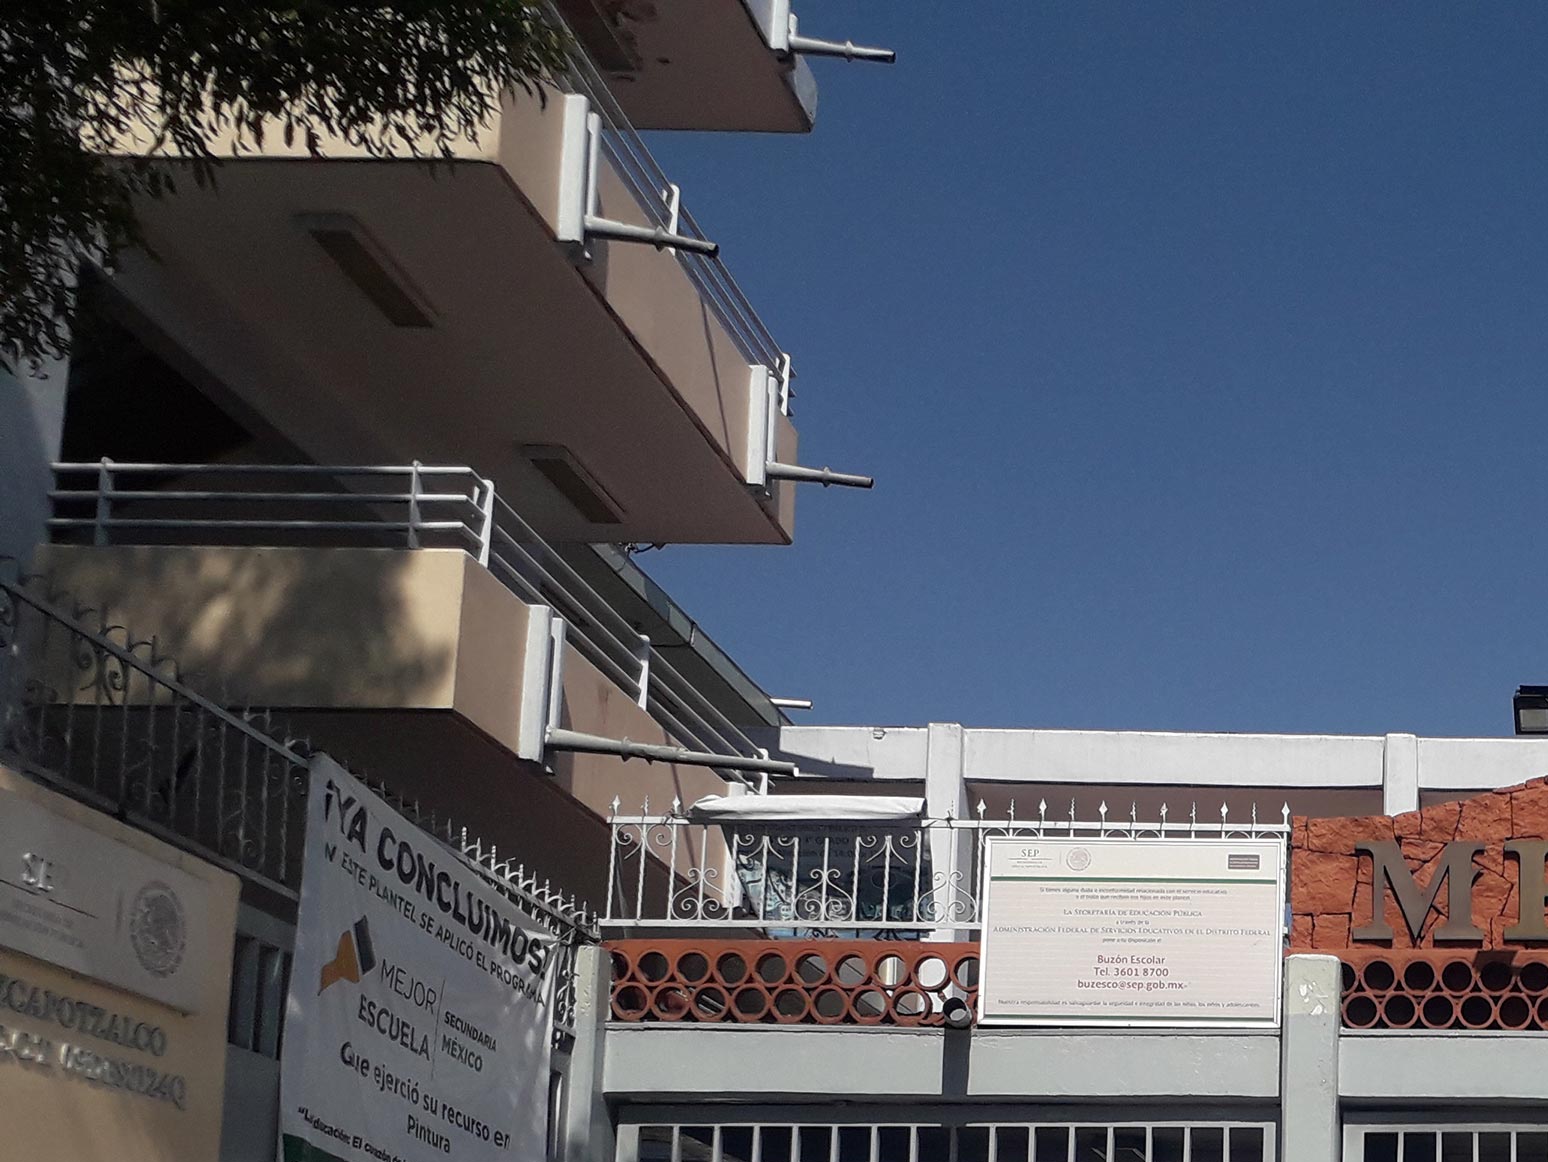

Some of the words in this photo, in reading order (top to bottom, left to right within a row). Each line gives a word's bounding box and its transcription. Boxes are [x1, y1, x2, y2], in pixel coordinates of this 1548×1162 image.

[1020, 848, 1040, 858] SEP
[341, 851, 368, 886] ESTE
[368, 874, 417, 924] PLANTEL
[418, 911, 435, 934] SE
[435, 924, 474, 961] APLICÓ
[476, 950, 488, 972] EL
[377, 826, 549, 981] CONCLUIMOS!
[1094, 967, 1110, 976] Tel.
[1113, 967, 1139, 976] 3601
[1142, 968, 1169, 977] 8700
[1097, 954, 1128, 965] Buzón
[1130, 955, 1166, 964] Escolar
[380, 958, 437, 1015] MEJOR
[1077, 980, 1184, 992] buzesco@sep.gob.mx
[357, 993, 430, 1061] ESCUELA
[443, 1010, 498, 1052] SECUNDARIA
[441, 1033, 484, 1073] MÉXICO
[373, 1064, 420, 1106] ejerció
[423, 1094, 439, 1116] su
[441, 1103, 490, 1143] recurso
[406, 1114, 451, 1154] Pintura
